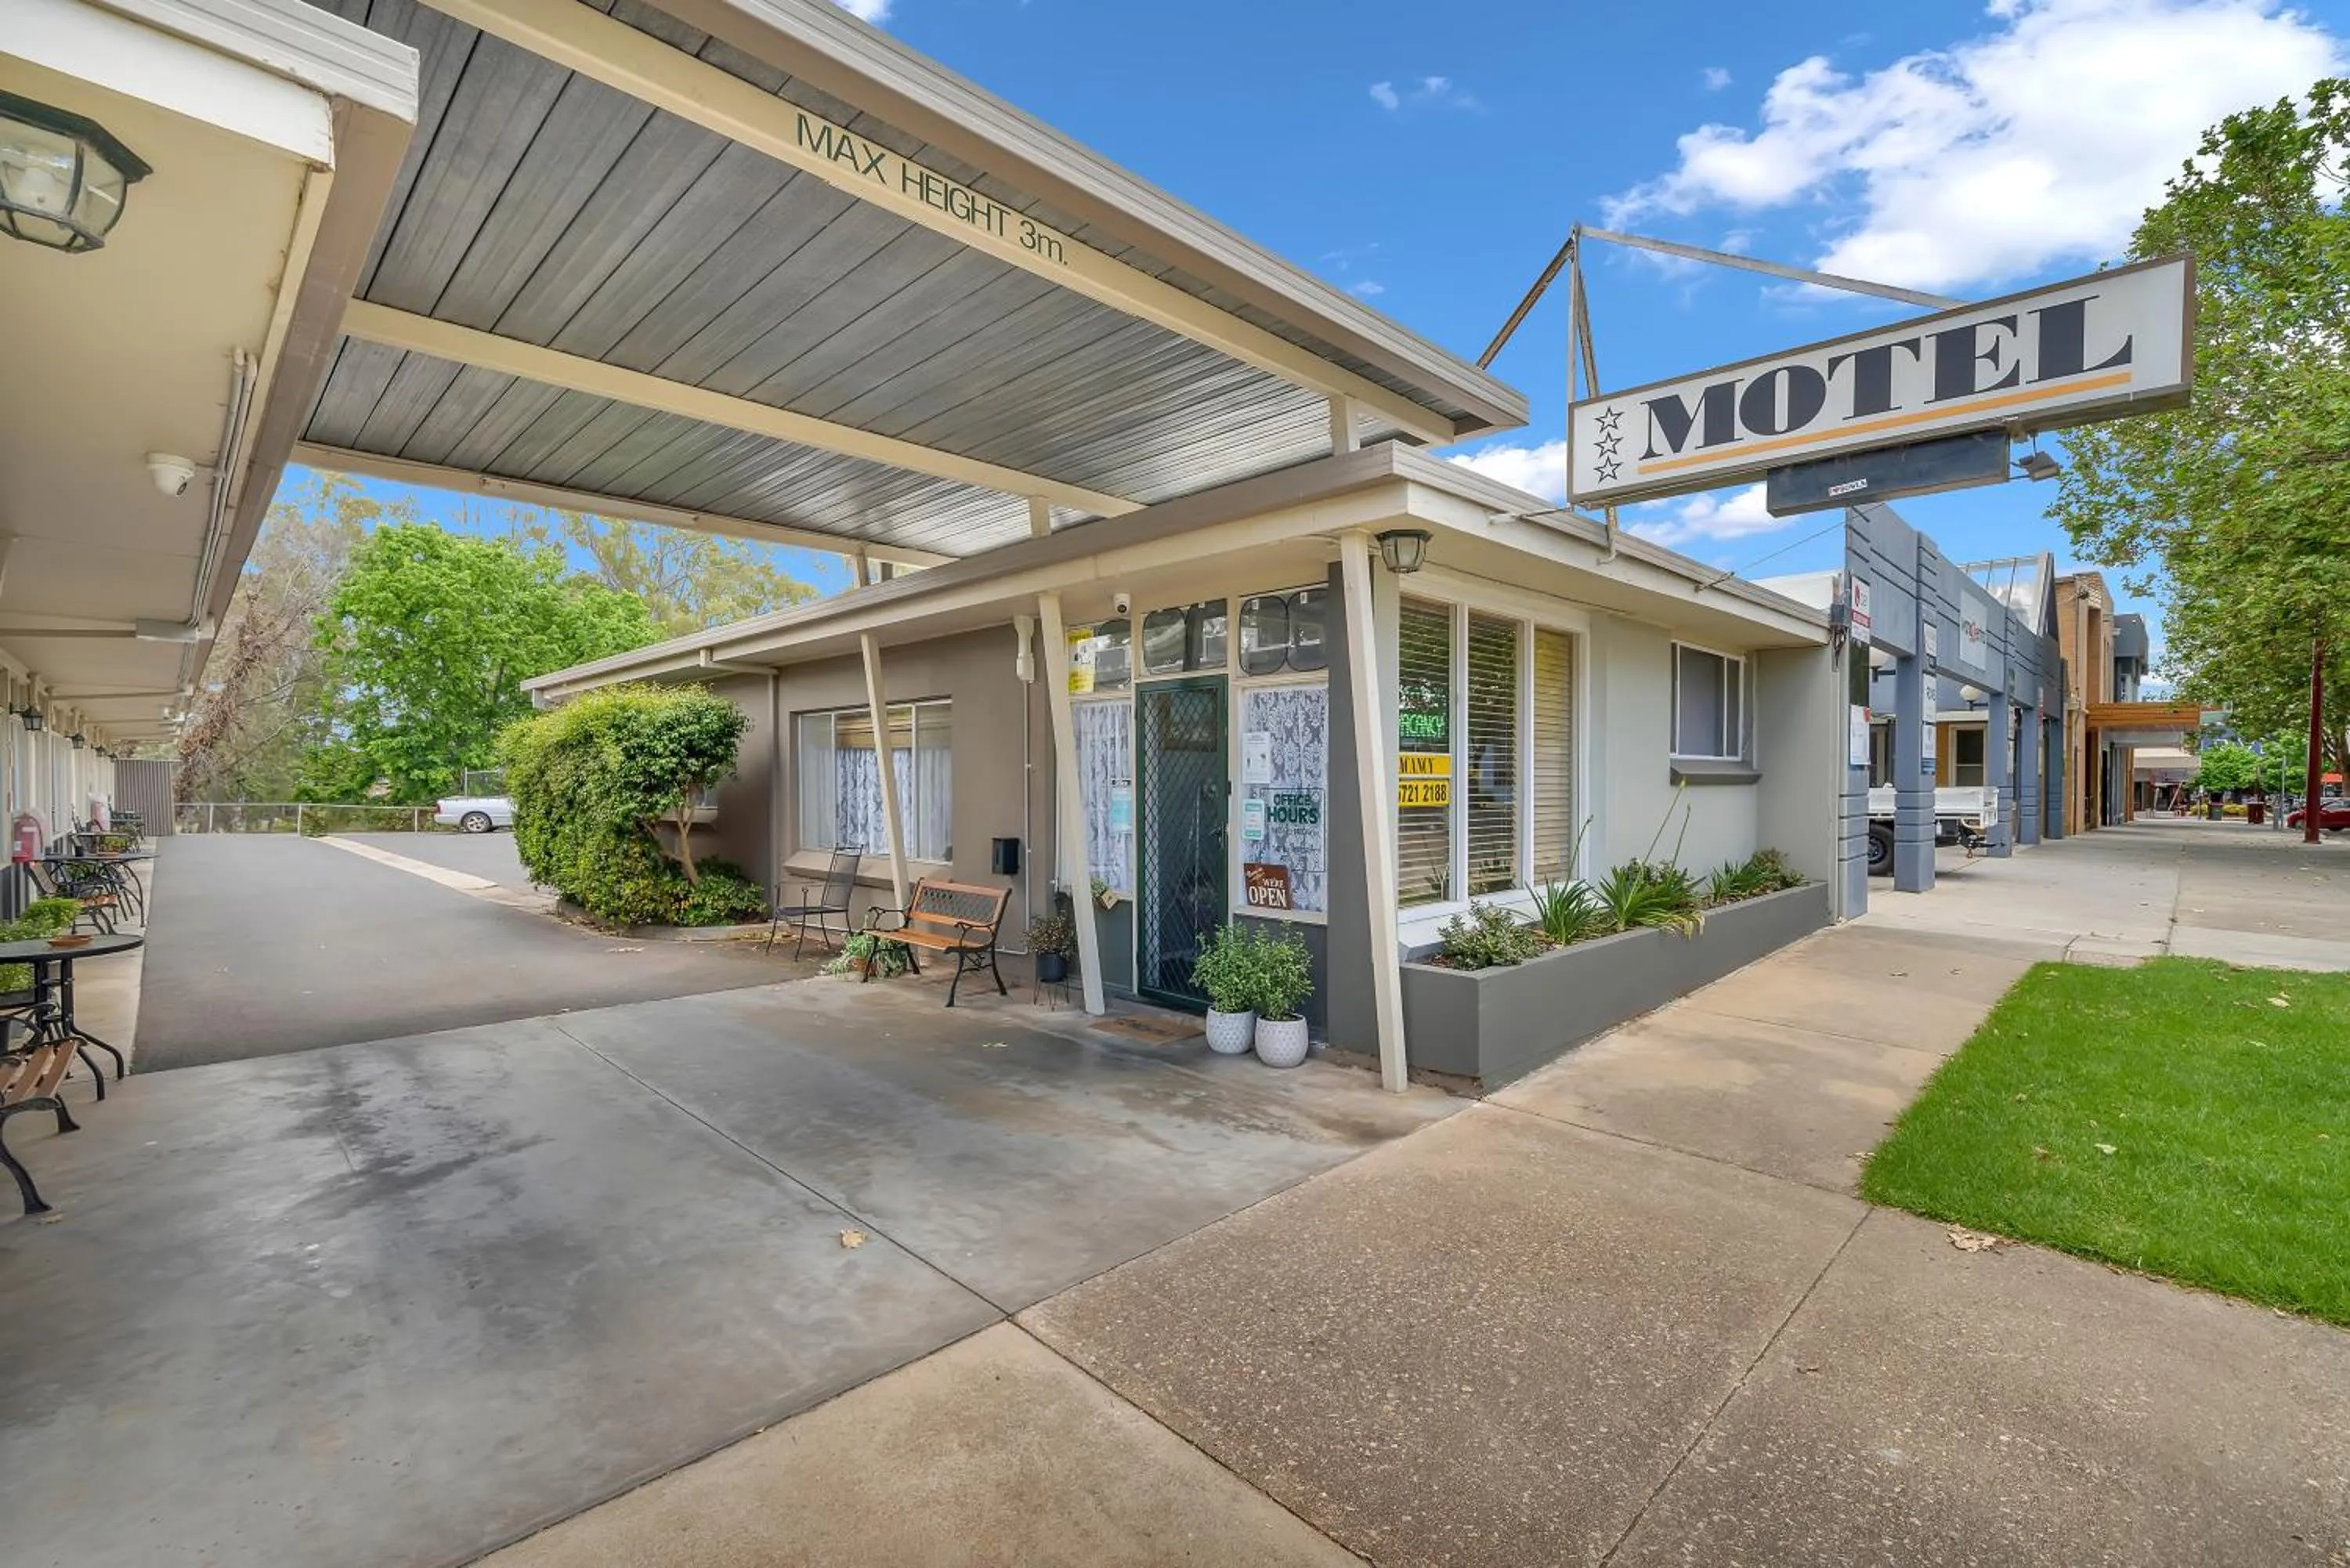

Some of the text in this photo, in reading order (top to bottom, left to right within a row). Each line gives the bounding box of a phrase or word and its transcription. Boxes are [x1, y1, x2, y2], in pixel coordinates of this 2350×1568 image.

[797, 113, 1068, 265] MAX HEIGHT 3m.
[1639, 295, 2132, 461] MOTEL
[1399, 714, 1445, 738] ACANCY
[1399, 757, 1434, 774] ACANCY
[1273, 793, 1311, 806] OFFICE
[1422, 784, 1447, 803] 2188
[1267, 806, 1319, 824] HOURS
[1248, 886, 1287, 908] OPEN
